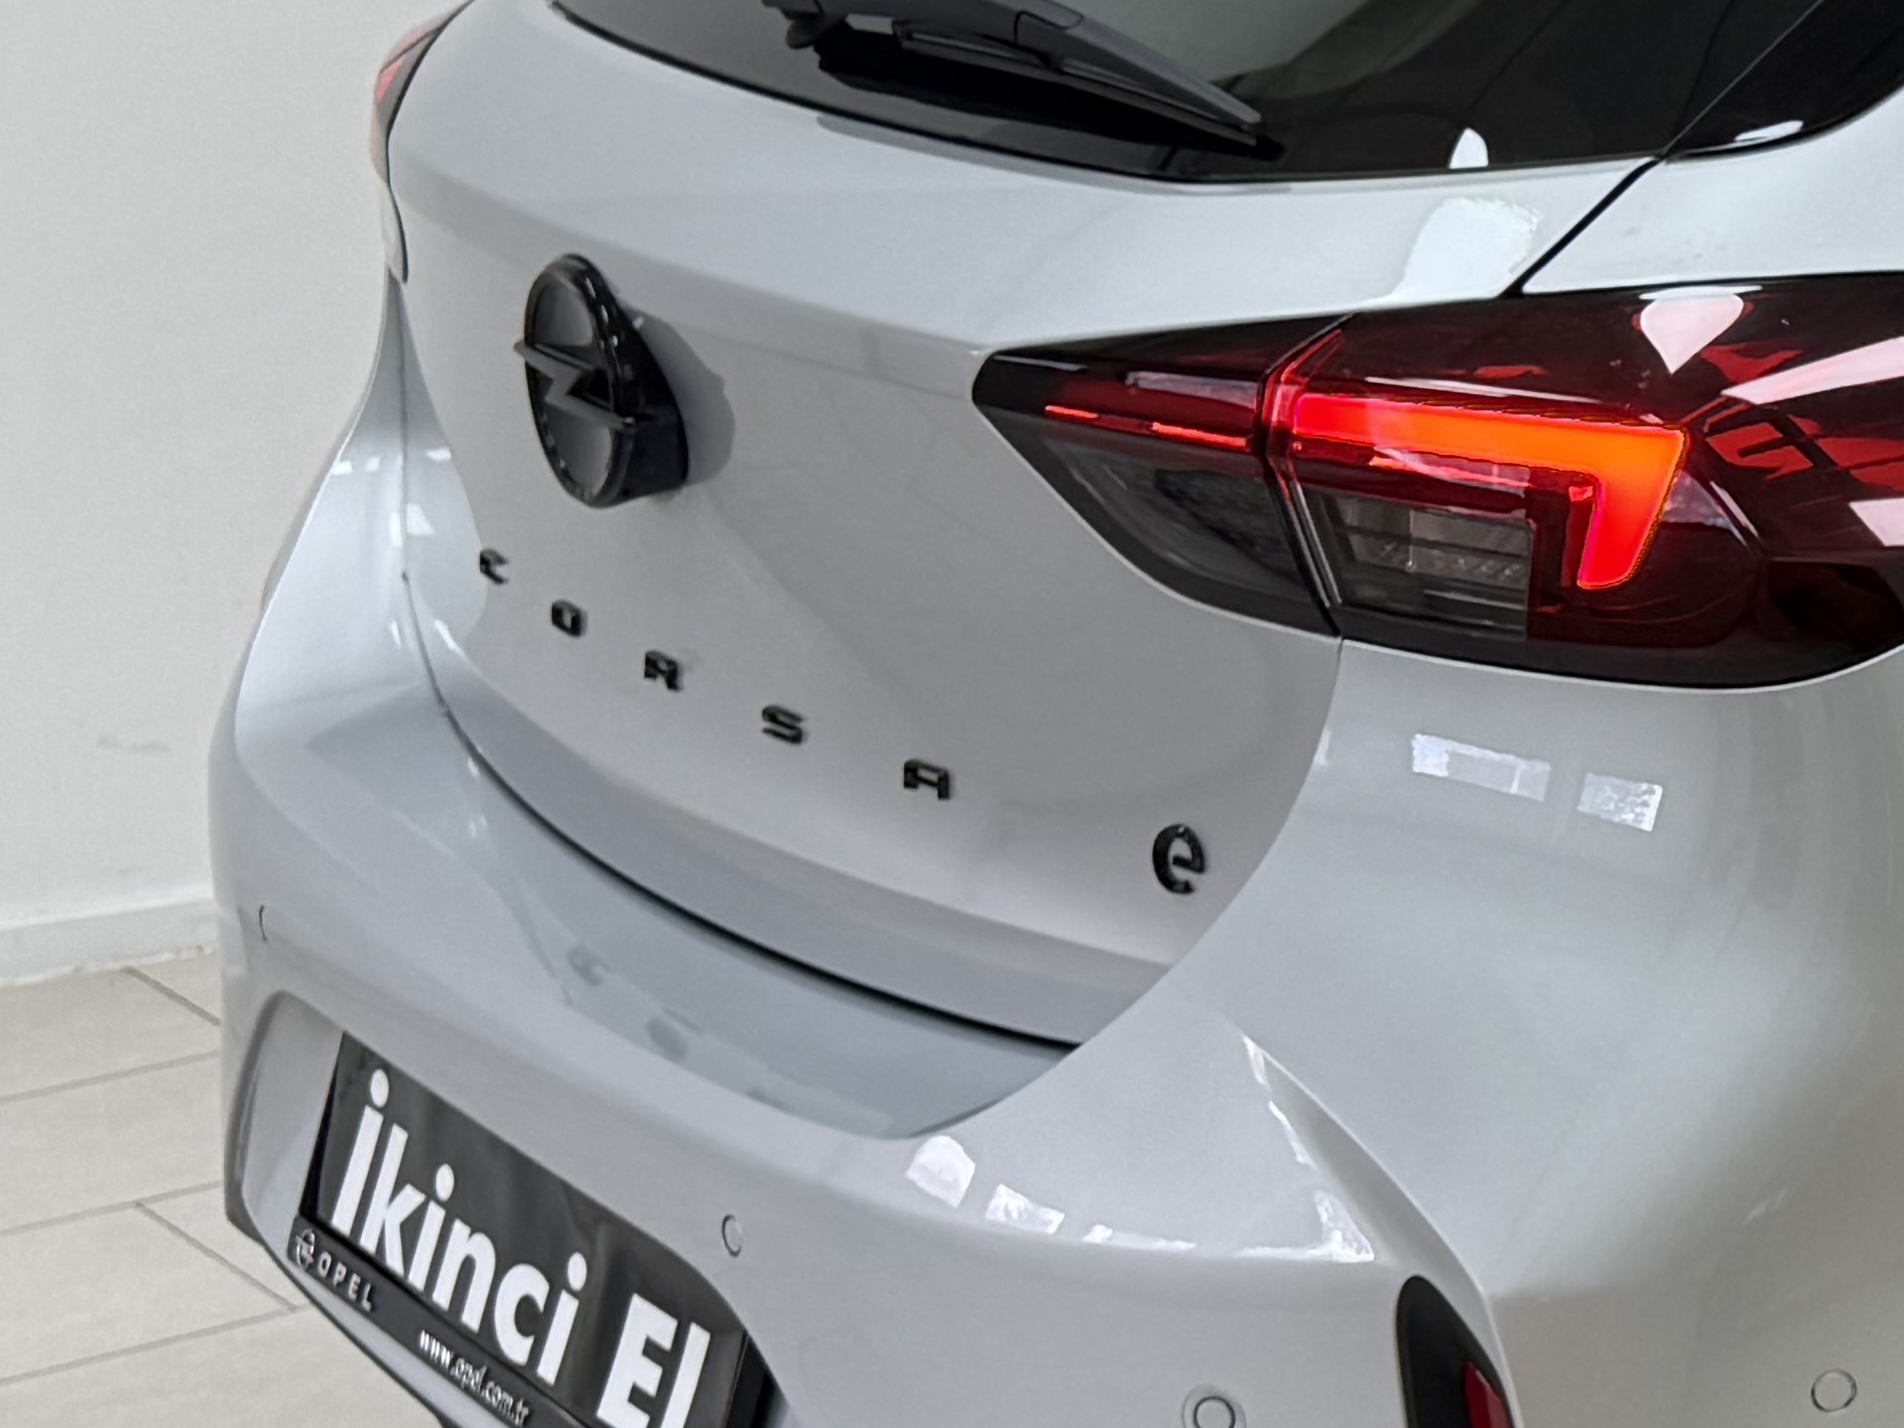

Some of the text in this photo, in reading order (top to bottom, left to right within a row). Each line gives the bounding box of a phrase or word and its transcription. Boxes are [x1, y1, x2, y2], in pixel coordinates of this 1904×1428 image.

[478, 547, 955, 801] CORSA
[1151, 823, 1208, 895] e
[330, 1069, 588, 1386] İkinci
[317, 1250, 373, 1312] OPEL
[418, 1329, 530, 1427] www.opel.com.tr
